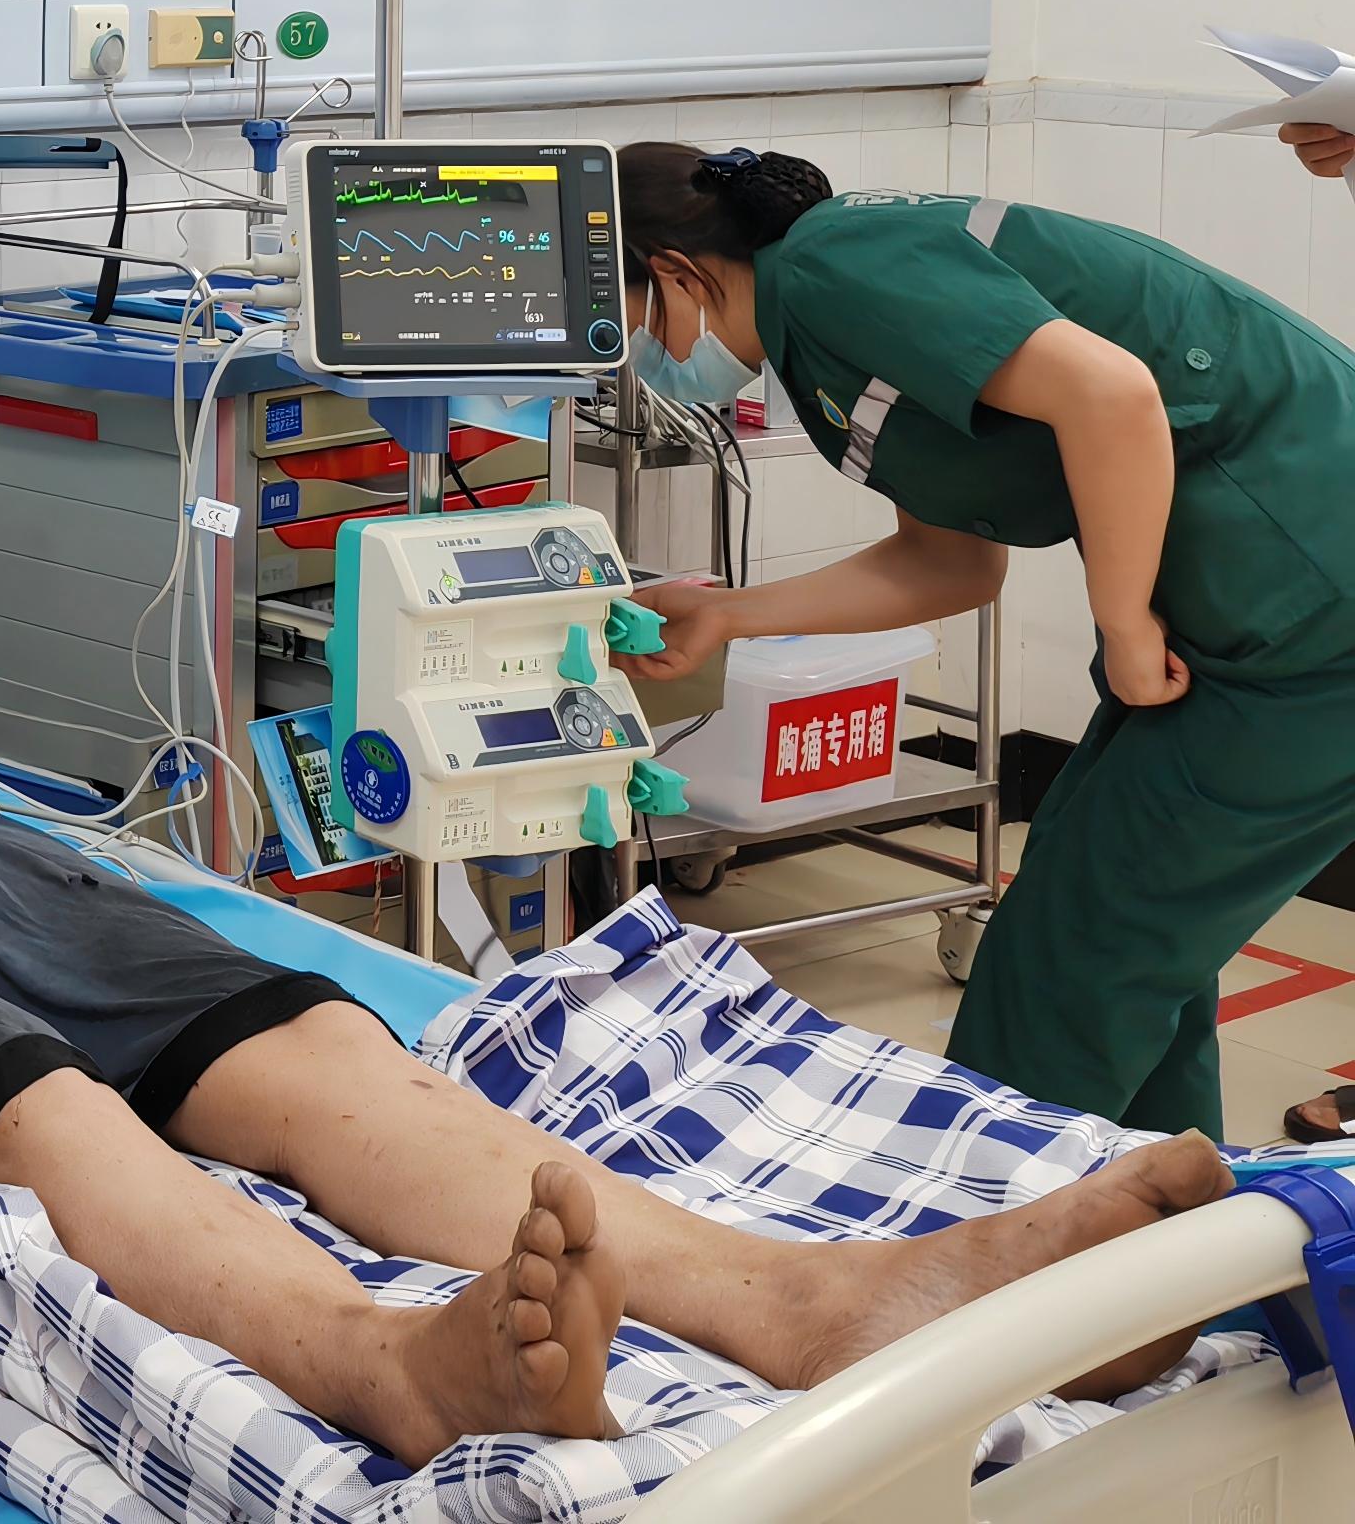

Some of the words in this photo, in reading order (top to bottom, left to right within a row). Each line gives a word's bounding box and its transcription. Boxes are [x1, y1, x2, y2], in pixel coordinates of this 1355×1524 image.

[291, 21, 316, 45] 57
[498, 230, 516, 244] 96
[501, 266, 516, 281] 13
[776, 703, 888, 777] 胸痛专用箱
